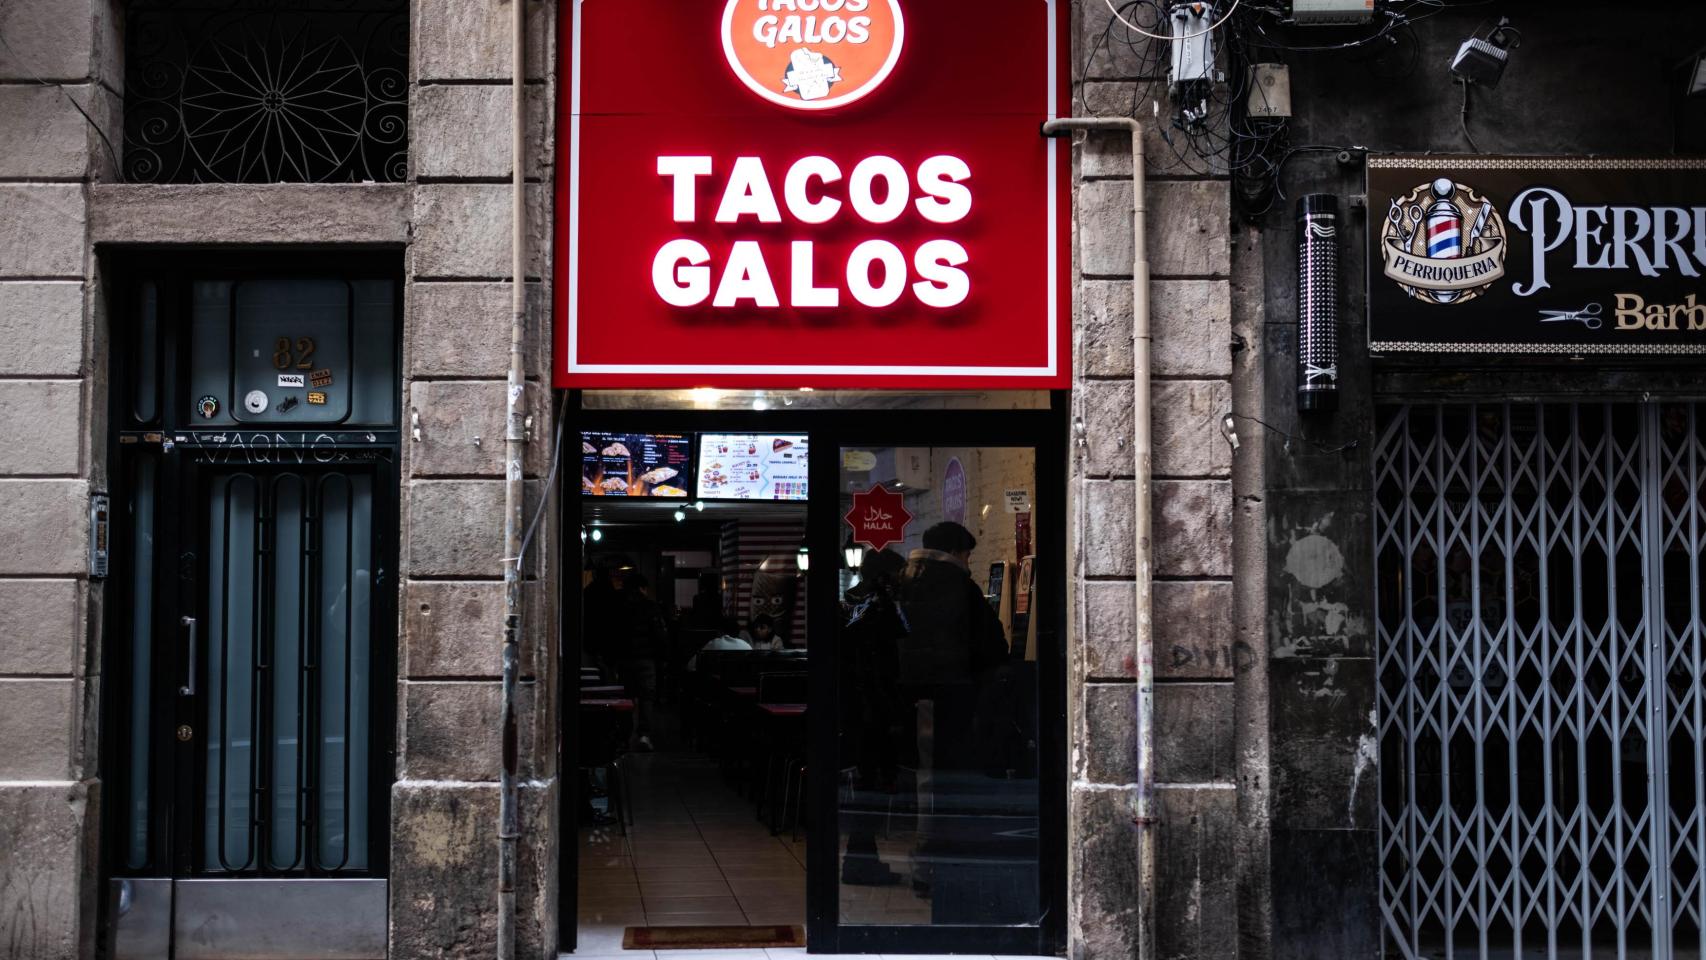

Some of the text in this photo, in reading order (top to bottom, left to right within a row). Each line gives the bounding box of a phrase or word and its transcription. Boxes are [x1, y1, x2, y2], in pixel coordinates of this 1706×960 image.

[752, 14, 871, 48] GALOS
[656, 155, 972, 224] TACOS
[651, 238, 970, 308] GALOS
[1392, 255, 1498, 284] PERRUQUERIA
[1613, 293, 1706, 331] Barb
[274, 337, 315, 369] 82
[863, 505, 893, 522] حلال
[863, 522, 893, 530] HALAL
